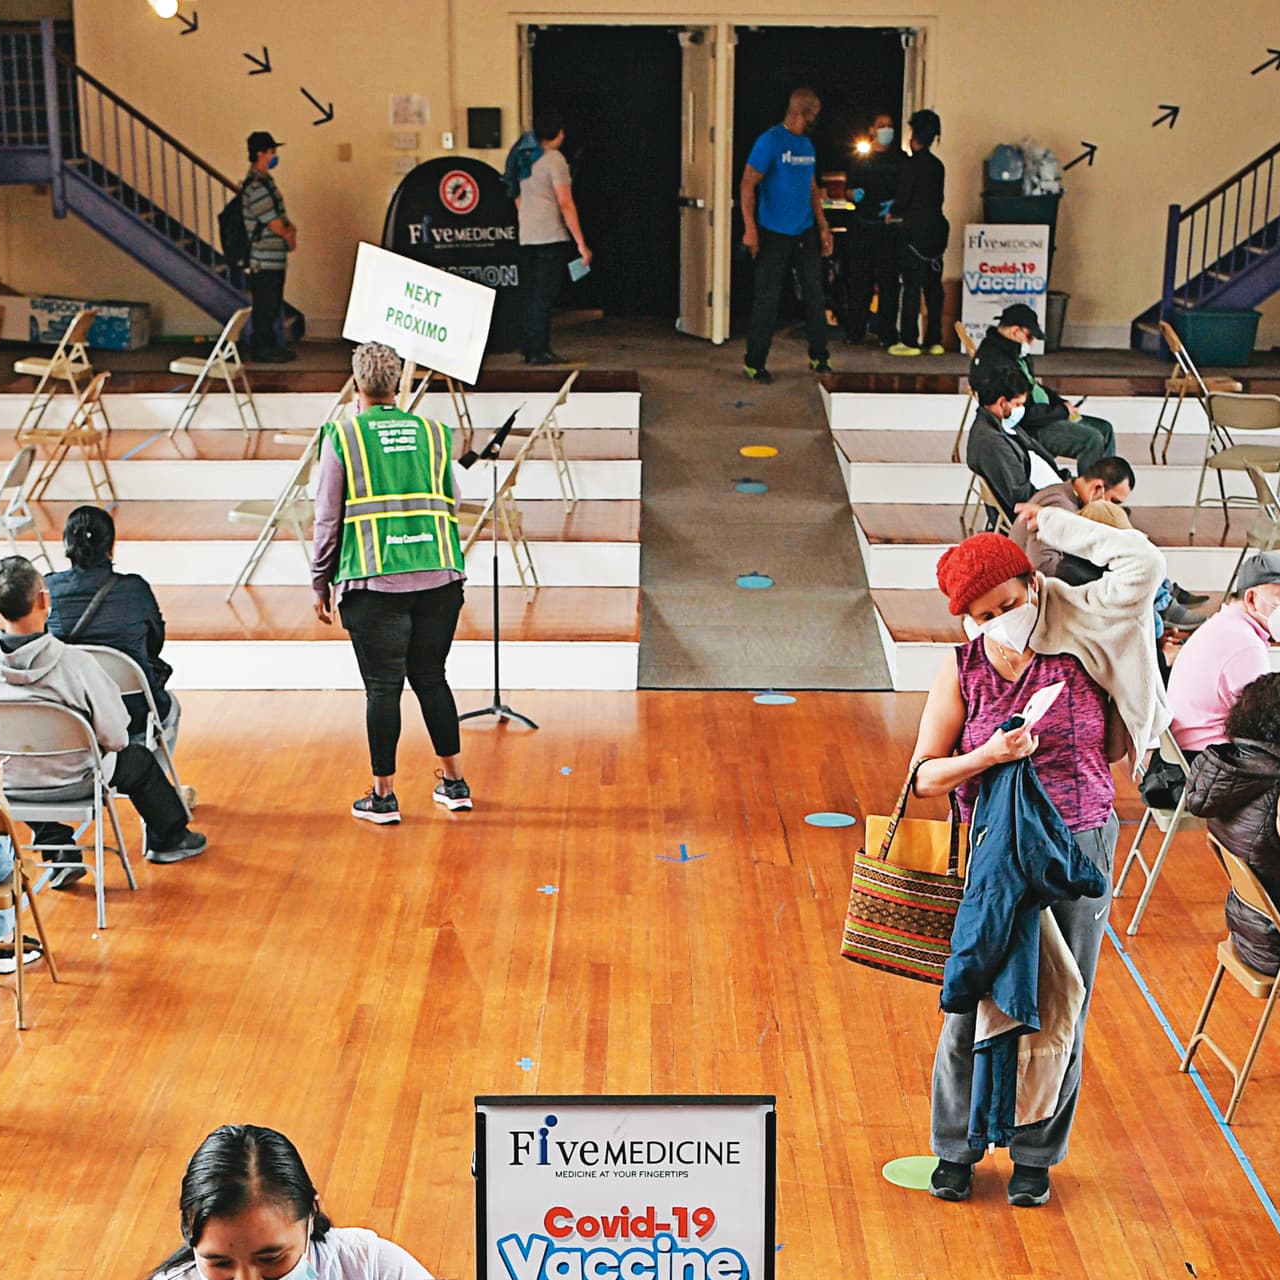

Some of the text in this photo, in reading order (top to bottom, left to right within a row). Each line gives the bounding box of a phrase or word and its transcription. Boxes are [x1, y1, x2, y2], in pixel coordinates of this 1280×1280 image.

[455, 226, 516, 241] MEDICINE
[978, 261, 1036, 274] Covid-19
[404, 281, 442, 308] NEXT
[963, 272, 1047, 295] Vaccine
[385, 306, 448, 343] PROXIMO
[508, 1114, 741, 1166] Five MEDICINE
[555, 1170, 689, 1179] MEDICINE AT YOUR FINGERTIPS
[543, 1205, 716, 1239] Covid-19
